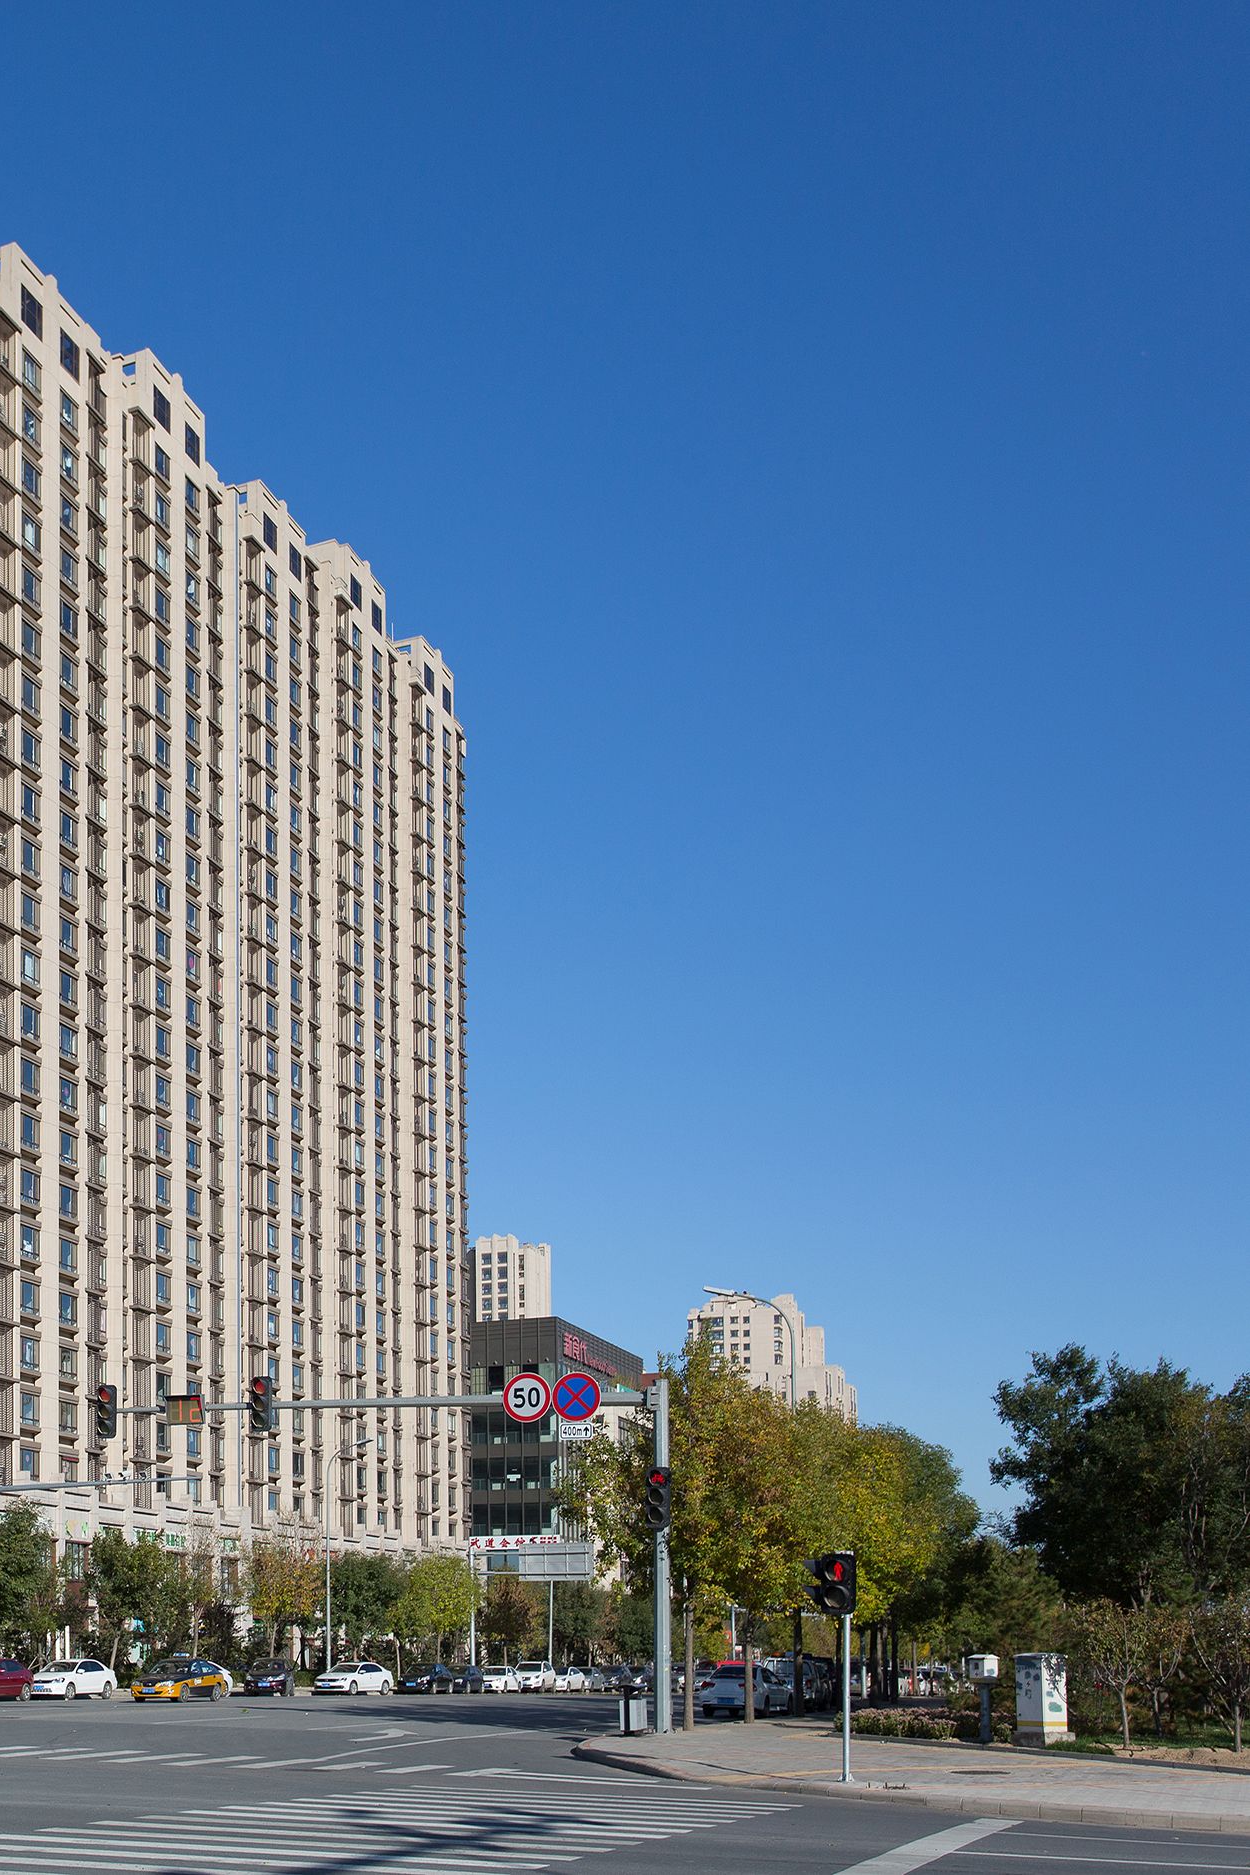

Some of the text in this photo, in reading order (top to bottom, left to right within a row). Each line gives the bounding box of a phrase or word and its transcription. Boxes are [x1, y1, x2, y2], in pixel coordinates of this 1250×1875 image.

[513, 1386, 541, 1409] 50
[178, 1397, 202, 1423] 12
[562, 1426, 583, 1436] 400m
